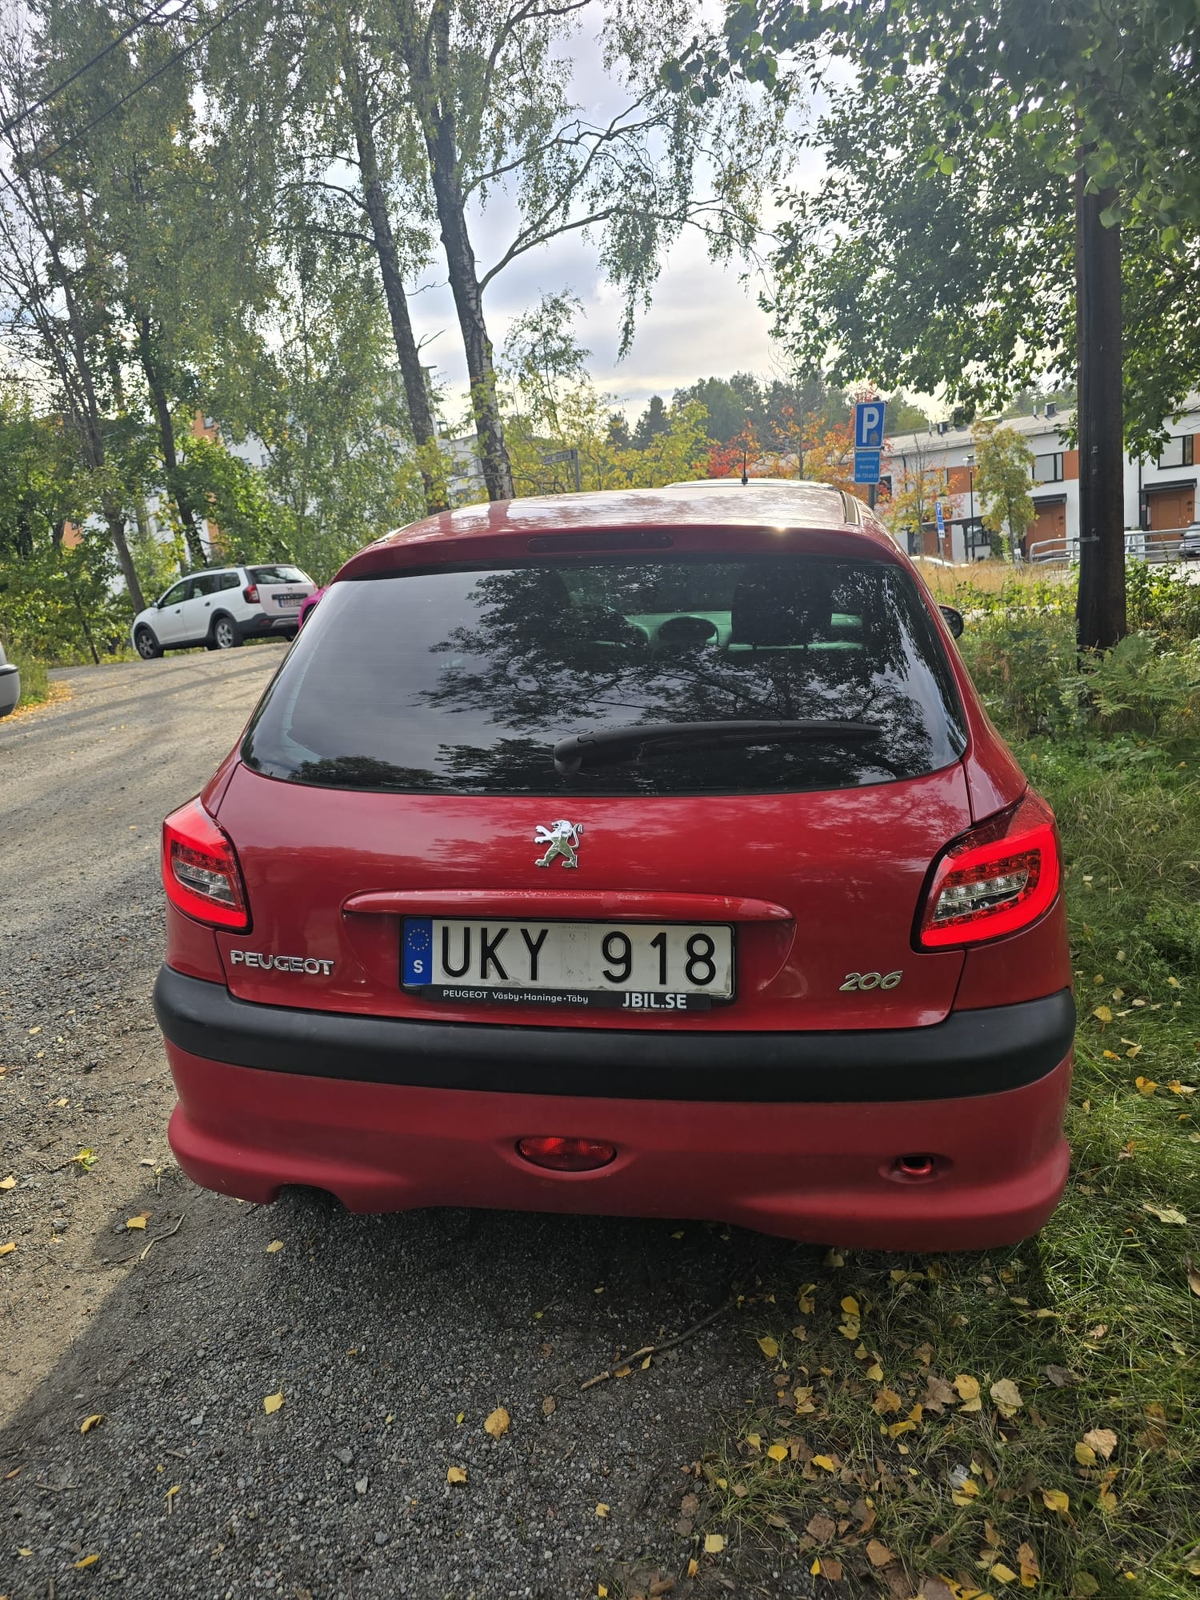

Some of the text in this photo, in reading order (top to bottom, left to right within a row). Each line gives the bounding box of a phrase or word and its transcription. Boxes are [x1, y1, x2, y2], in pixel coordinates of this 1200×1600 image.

[862, 407, 879, 443] P
[230, 950, 334, 975] PEUGEOT
[413, 959, 424, 973] S
[442, 926, 716, 986] UKY 918
[839, 970, 903, 991] 206
[442, 989, 488, 999] PEUGEOT
[622, 992, 687, 1009] JBIL.SE
